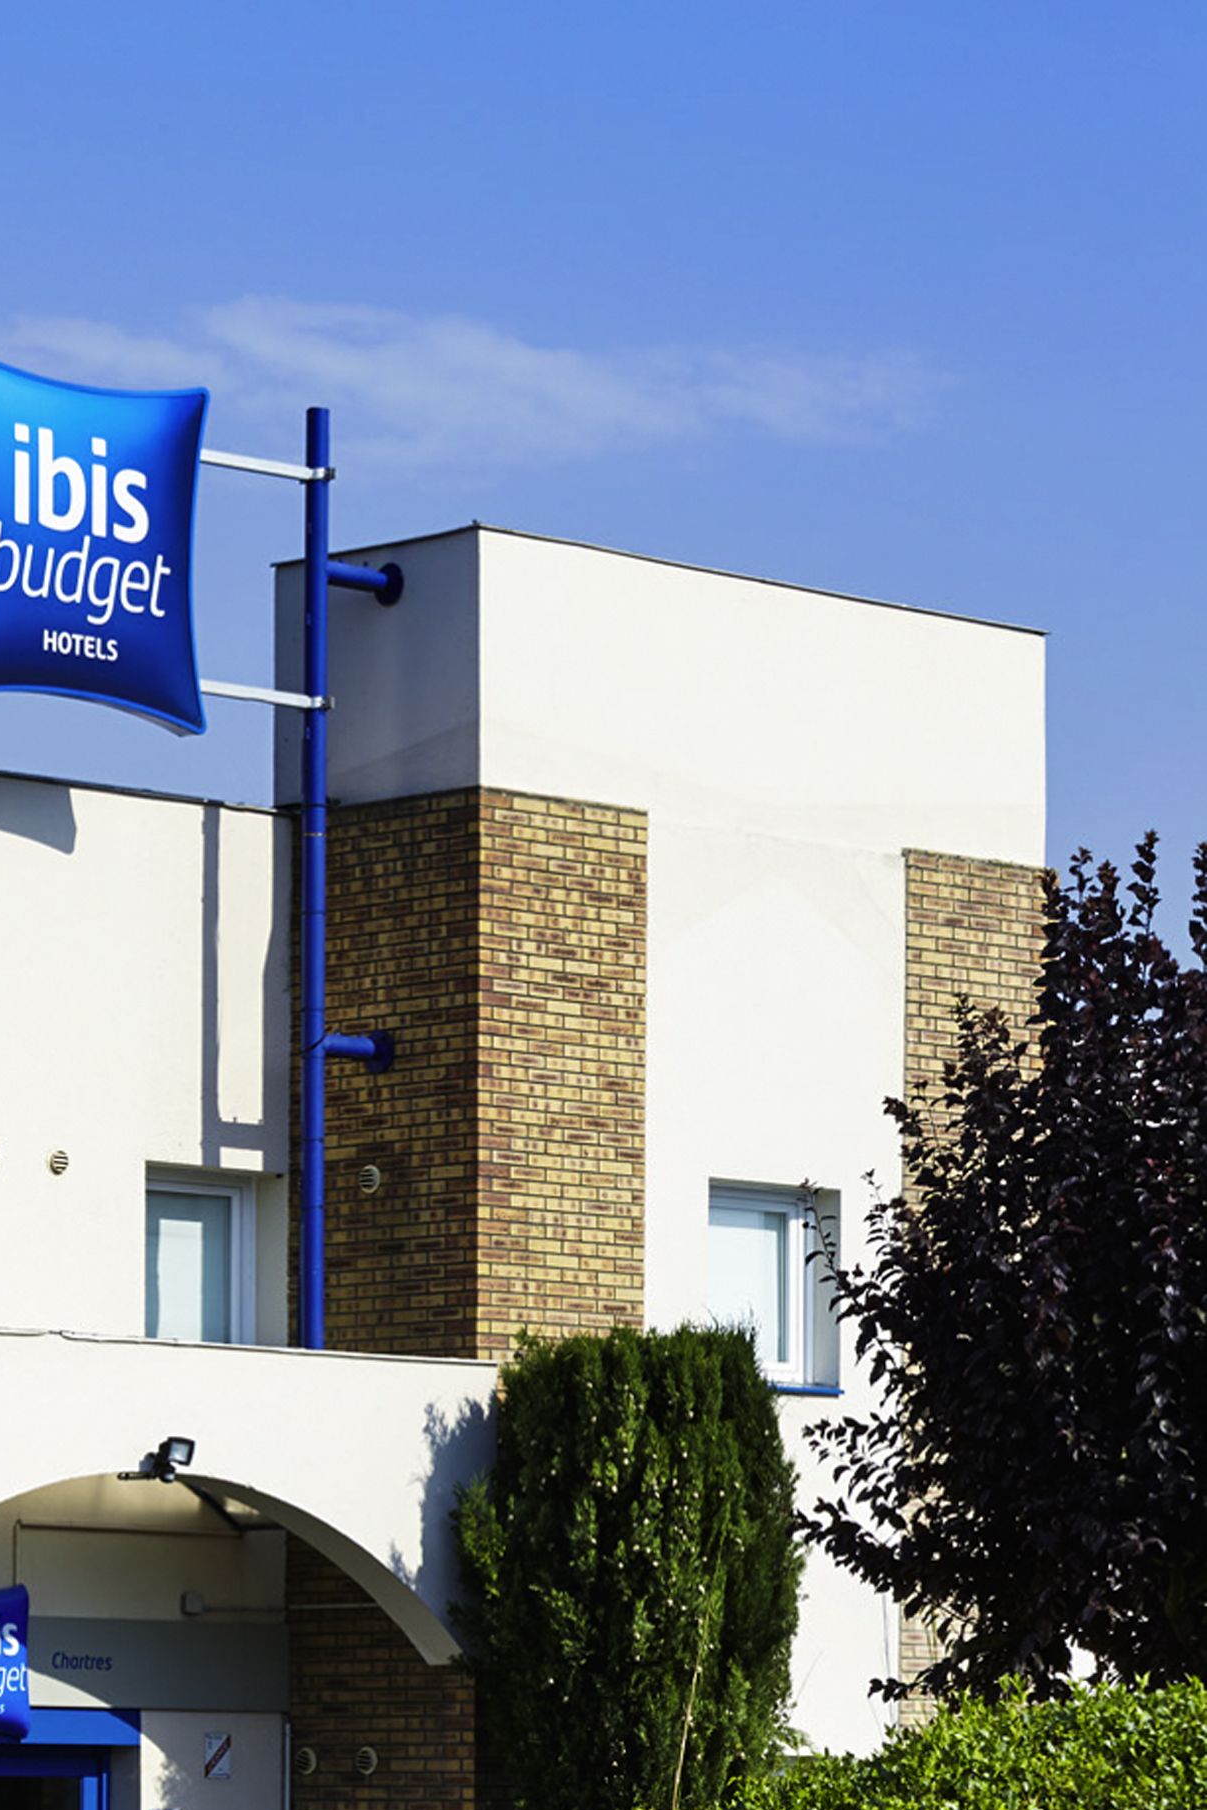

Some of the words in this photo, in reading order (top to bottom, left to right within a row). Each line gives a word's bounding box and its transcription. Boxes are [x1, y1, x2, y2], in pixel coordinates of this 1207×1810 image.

[14, 422, 149, 544] ibis
[43, 629, 119, 662] HOTELS
[52, 1651, 113, 1671] Chartres
